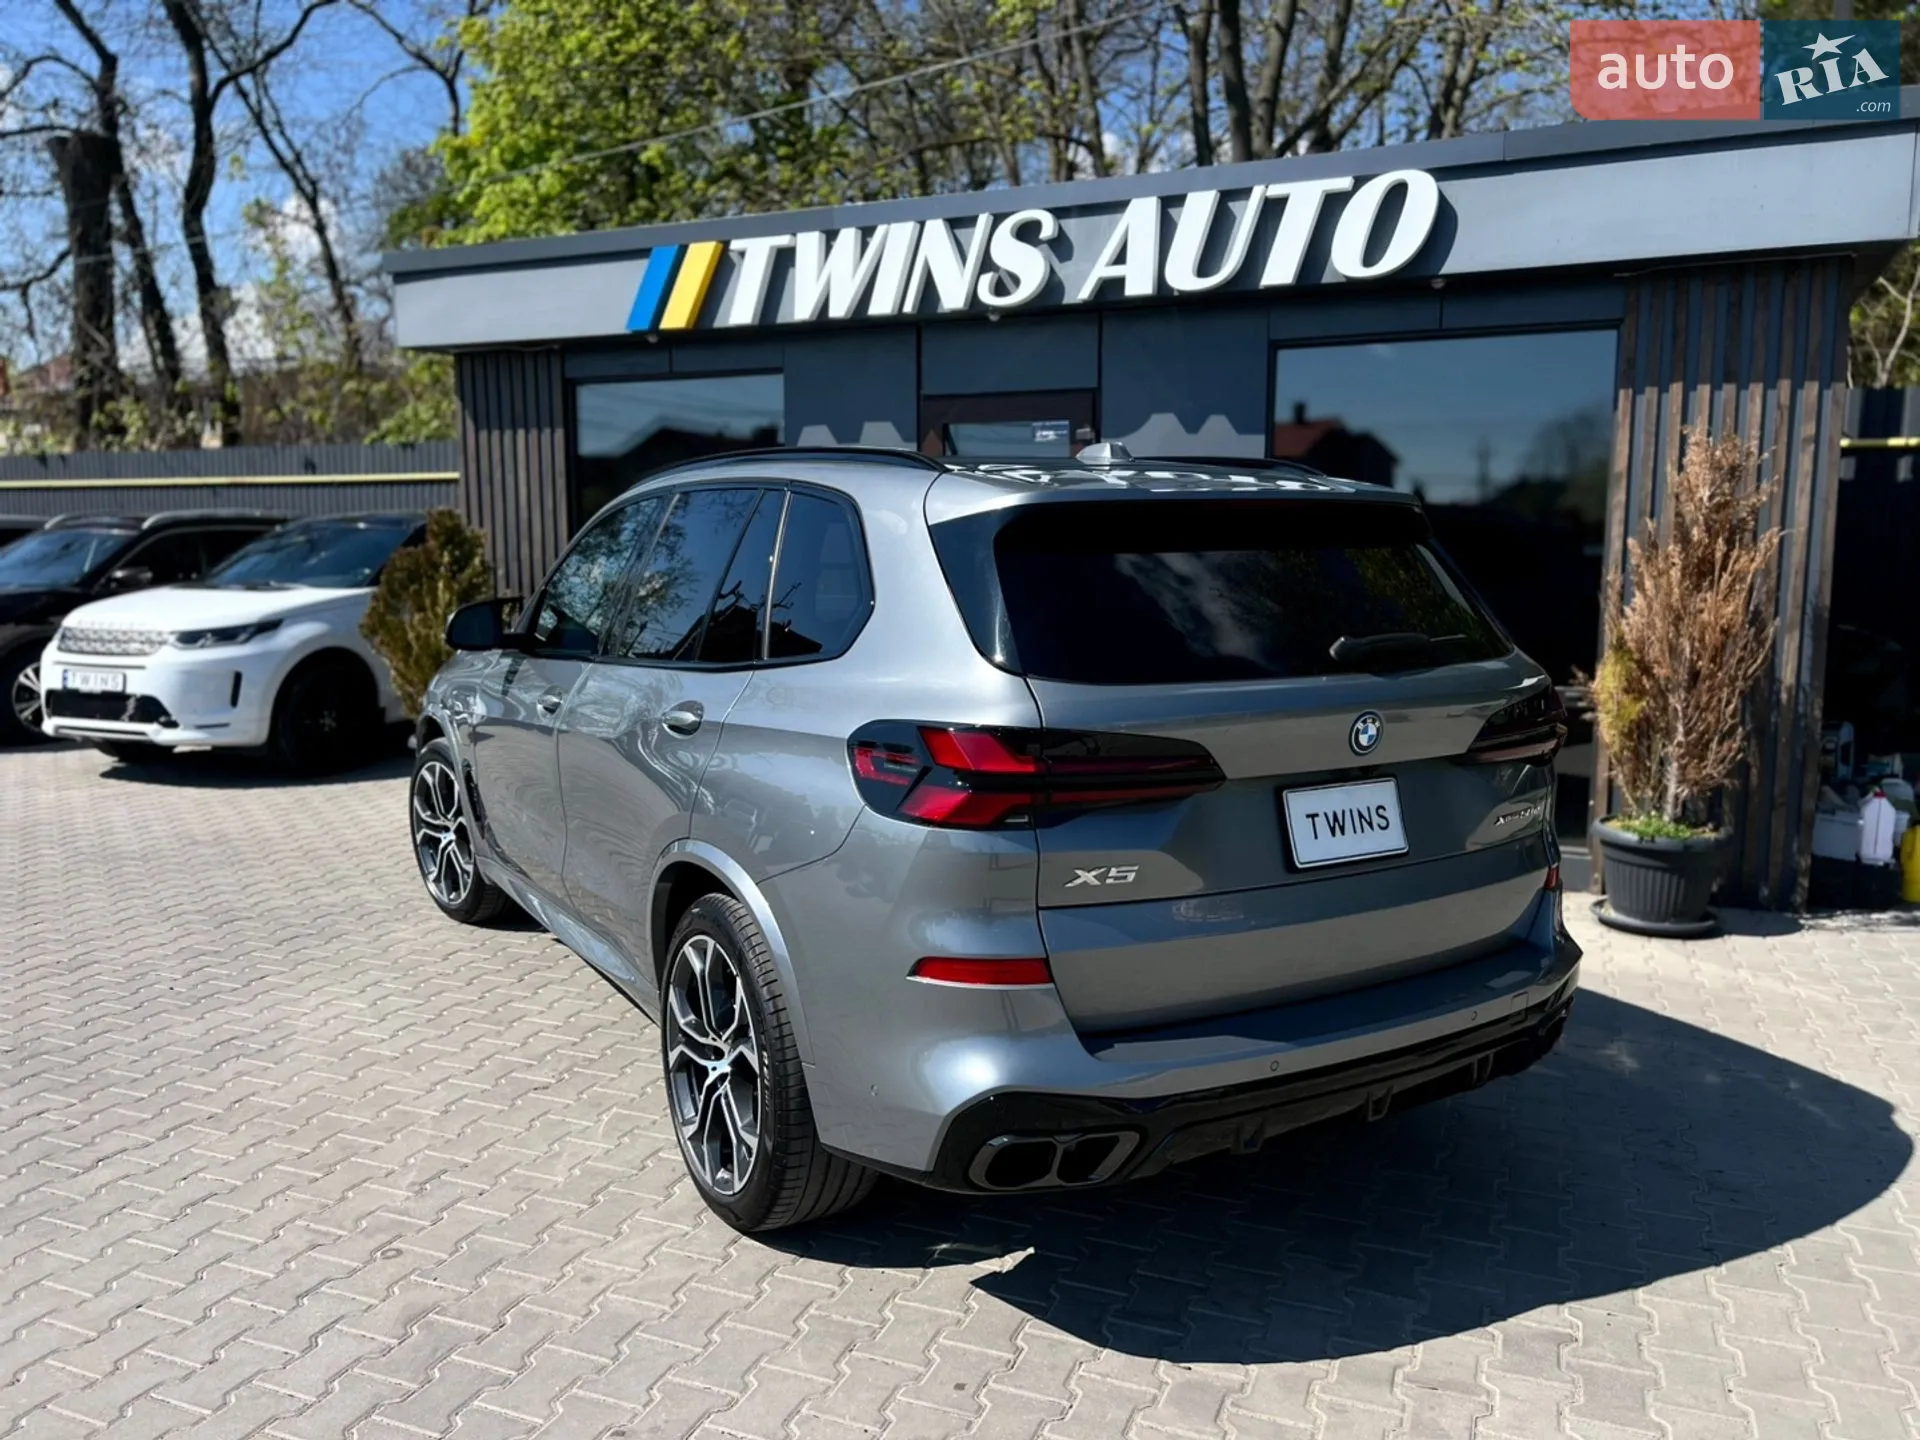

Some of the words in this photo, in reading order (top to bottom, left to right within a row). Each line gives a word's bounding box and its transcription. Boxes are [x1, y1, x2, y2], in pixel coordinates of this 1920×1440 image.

[726, 208, 1060, 326] TWINS
[1078, 168, 1440, 302] AUTO
[70, 671, 120, 690] TWINS
[1305, 804, 1390, 840] TWINS
[1064, 865, 1140, 888] X5
